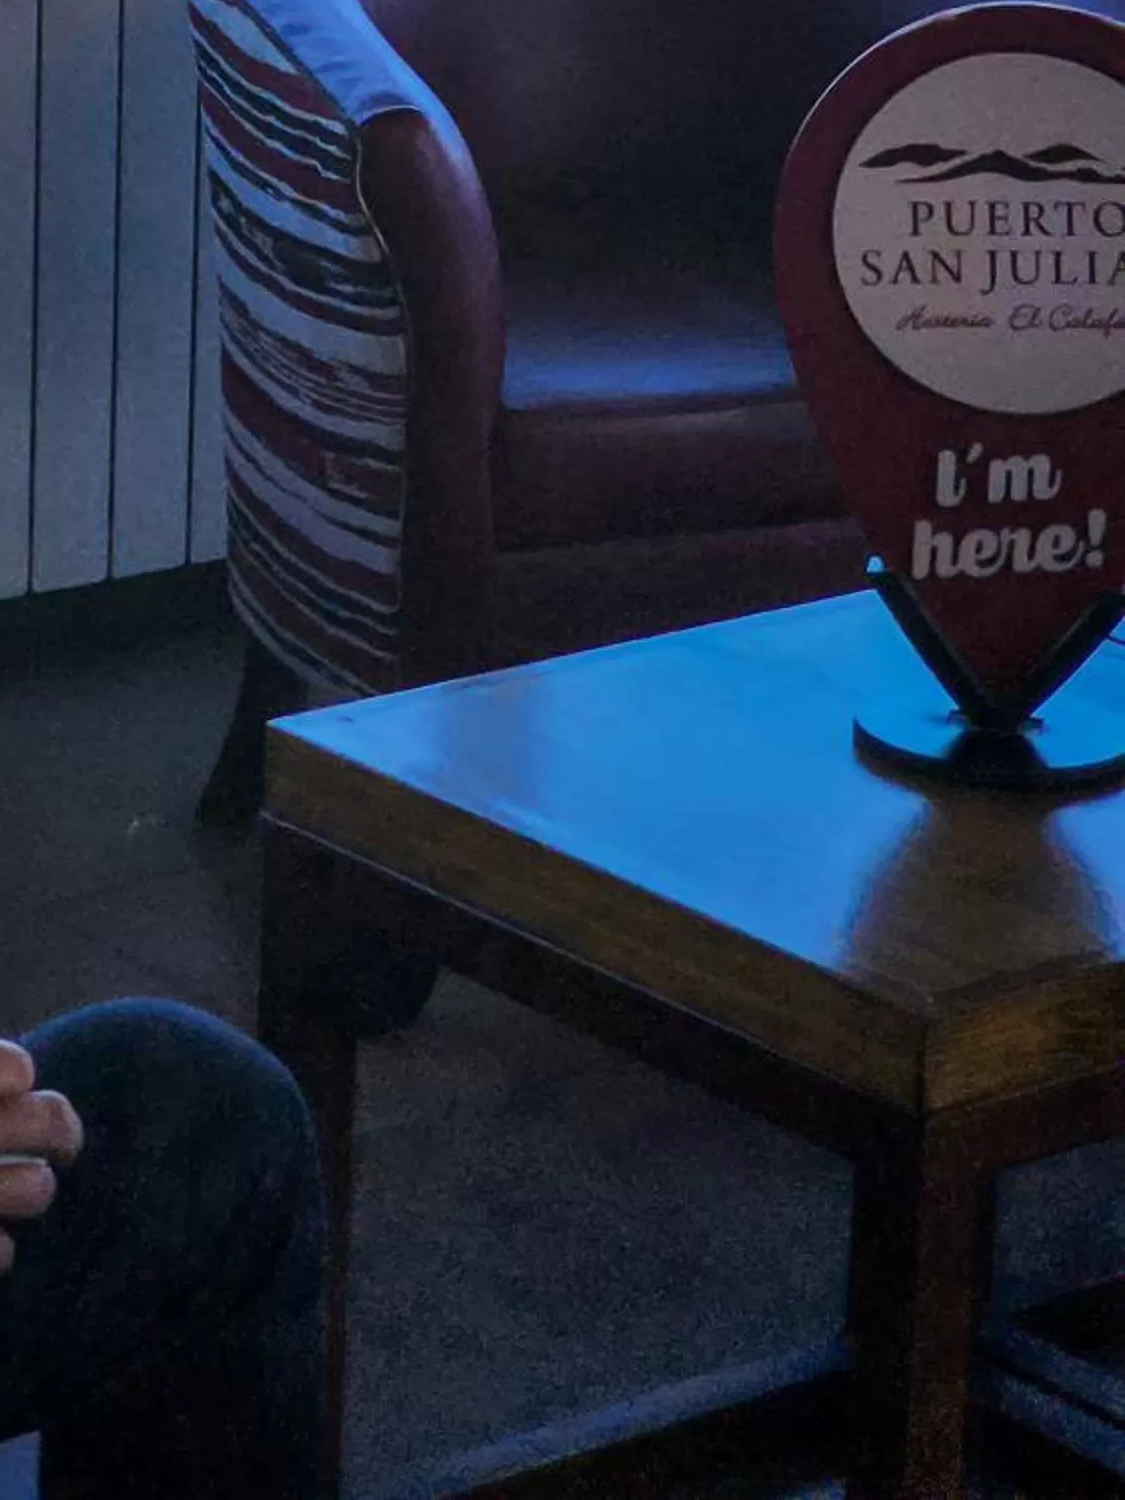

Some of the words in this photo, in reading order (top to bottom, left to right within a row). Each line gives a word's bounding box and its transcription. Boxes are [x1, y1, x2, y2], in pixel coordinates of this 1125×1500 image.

[909, 200, 1125, 237] PUERTO
[859, 249, 963, 286] SAN
[1008, 303, 1042, 332] El
[912, 508, 1107, 580] here!
